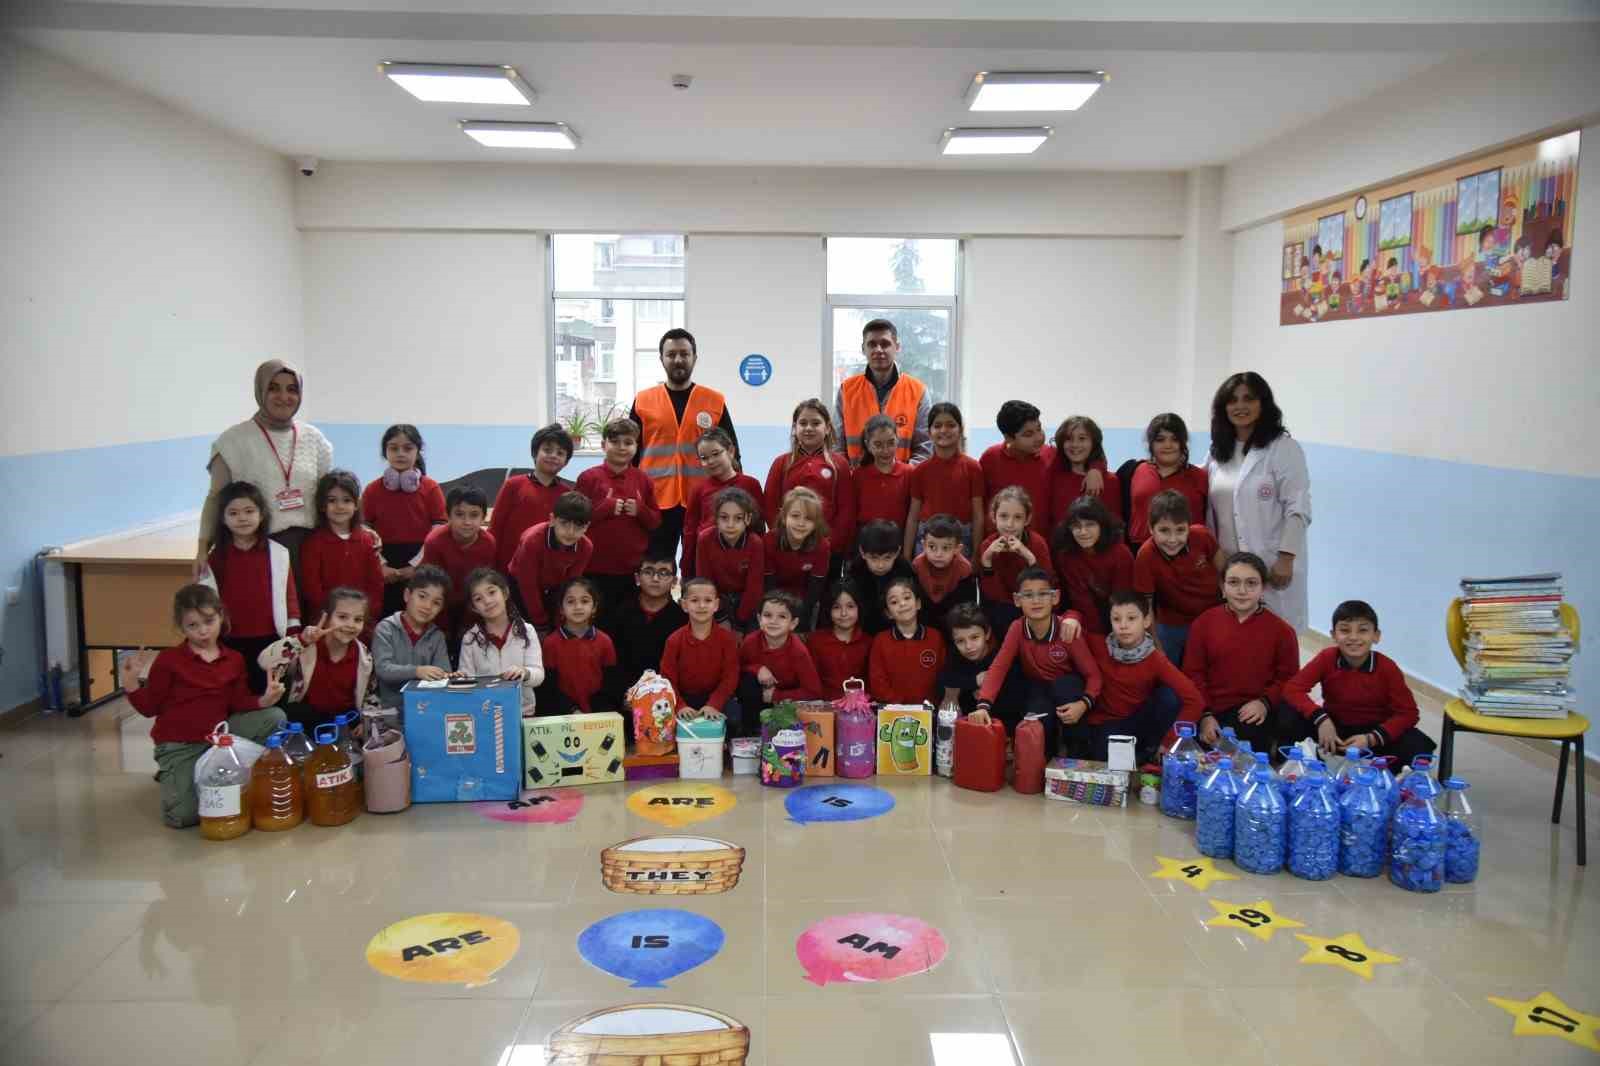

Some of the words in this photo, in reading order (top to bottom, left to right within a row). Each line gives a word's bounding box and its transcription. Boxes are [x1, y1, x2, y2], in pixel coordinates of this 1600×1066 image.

[320, 771, 348, 785] ATIK
[507, 796, 555, 810] AM
[647, 797, 715, 807] ARE
[820, 796, 853, 808] IS
[626, 871, 711, 880] THEY
[1181, 865, 1203, 878] 4
[1228, 908, 1271, 928] 19
[402, 930, 491, 961] ARE
[631, 936, 669, 948] IS
[837, 933, 902, 960] AM
[1325, 945, 1367, 962] 8
